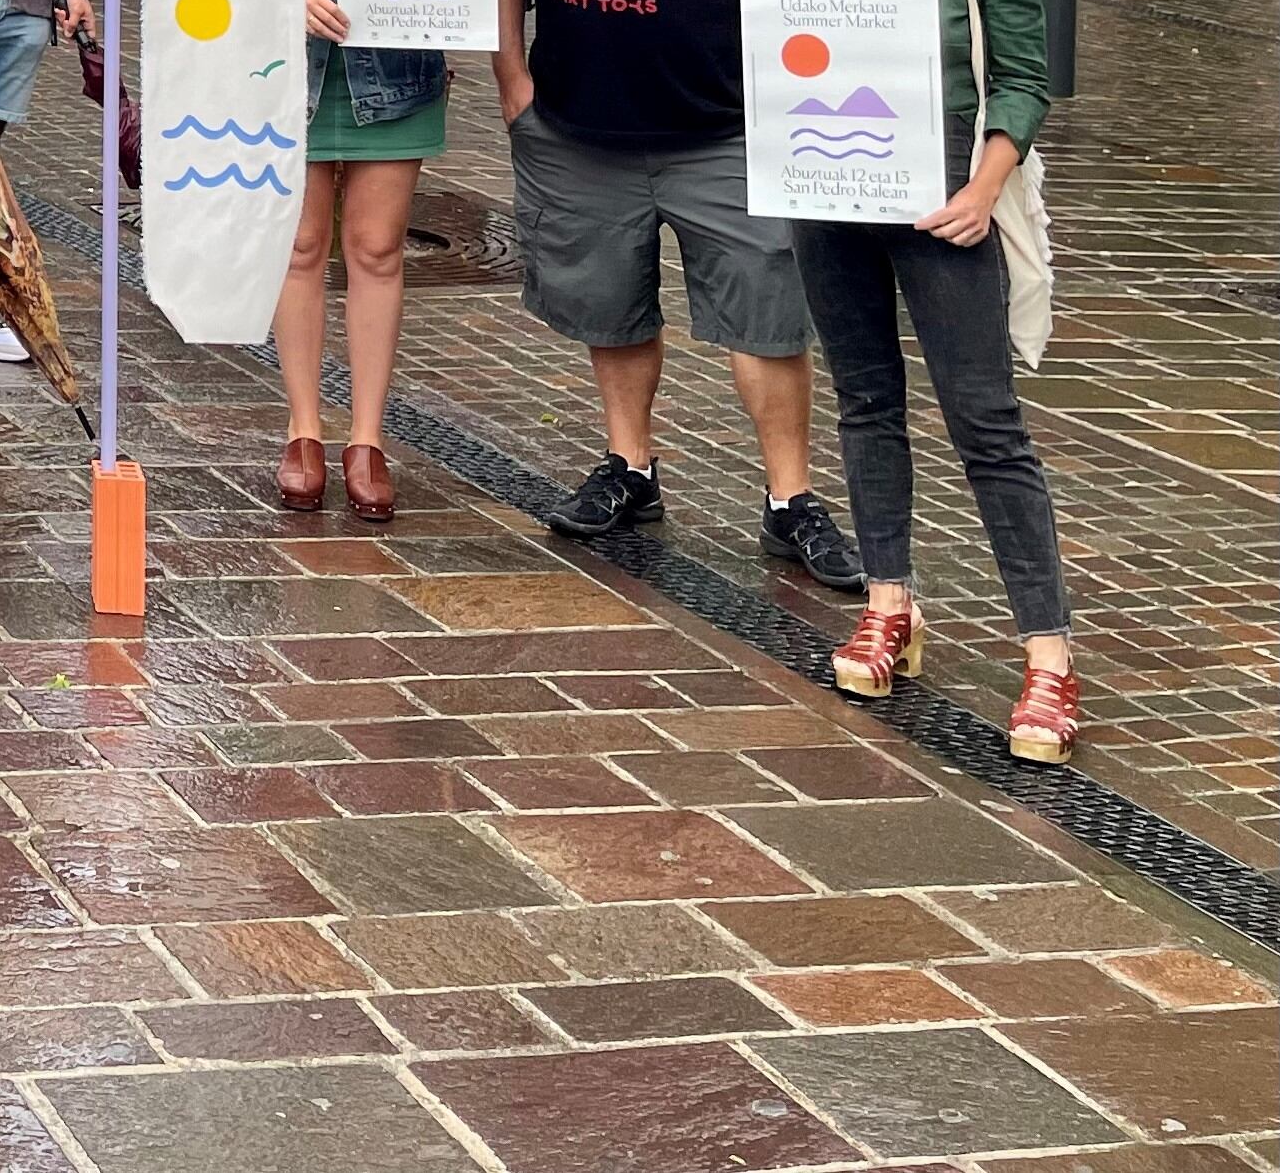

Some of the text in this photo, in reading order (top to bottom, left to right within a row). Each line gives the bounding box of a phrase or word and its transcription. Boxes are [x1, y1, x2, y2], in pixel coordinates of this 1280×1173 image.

[366, 3, 419, 16] Abuztuak
[423, 5, 434, 16] 12
[437, 6, 455, 17] eta
[781, 0, 898, 15] Udako Merkatua
[367, 16, 468, 30] San Pedro Kalean
[783, 13, 895, 30] Summer Market
[781, 165, 847, 182] Abuztuak
[852, 168, 866, 183] 12
[869, 170, 891, 184] eta
[783, 180, 908, 200] San Pedro Kalean
